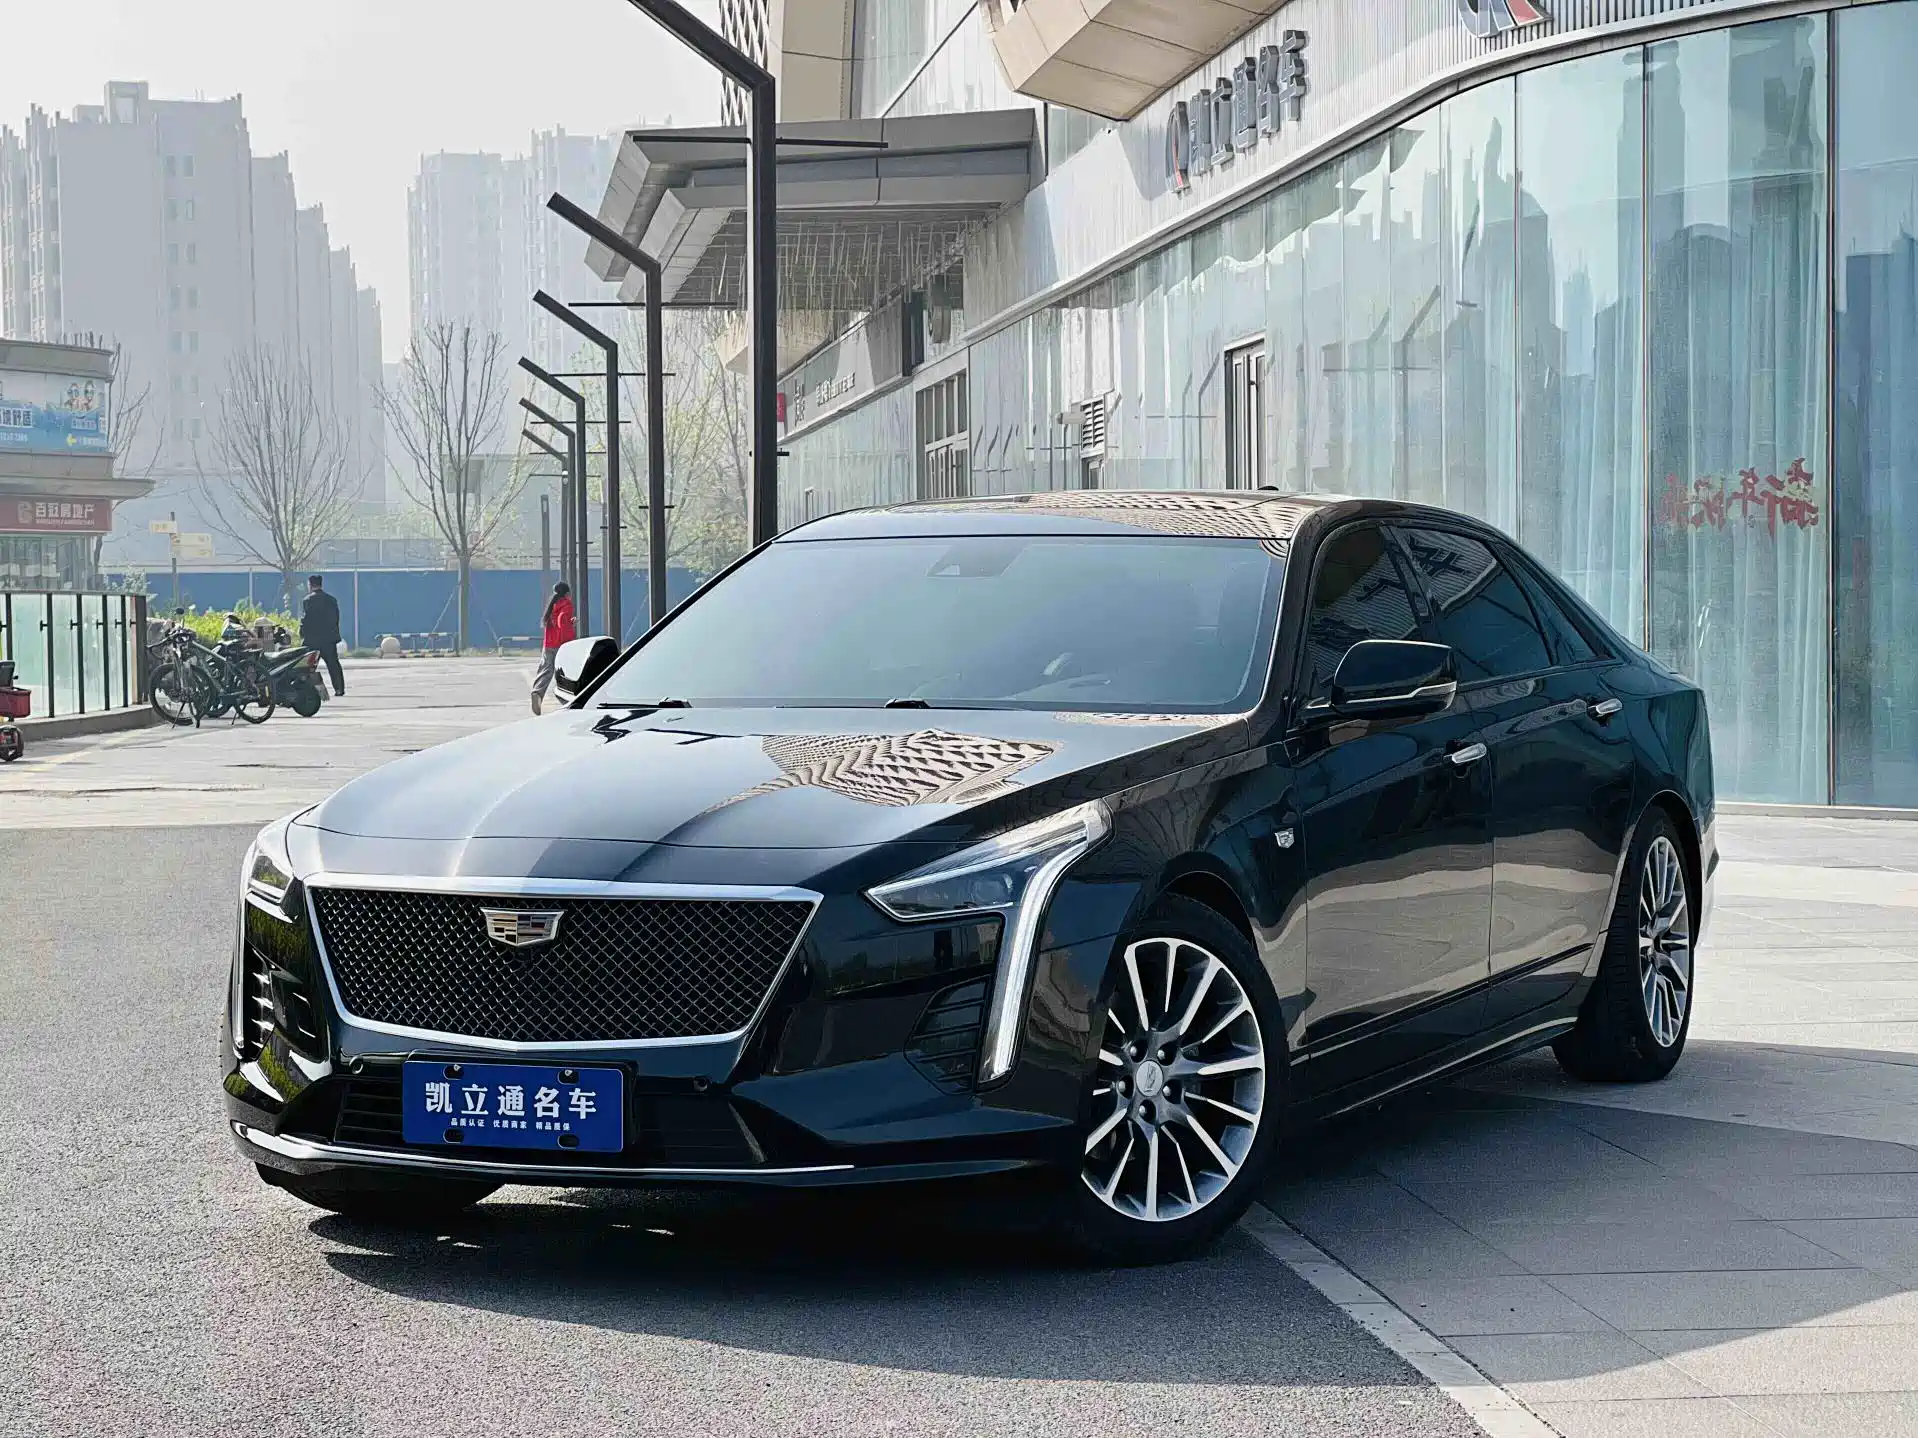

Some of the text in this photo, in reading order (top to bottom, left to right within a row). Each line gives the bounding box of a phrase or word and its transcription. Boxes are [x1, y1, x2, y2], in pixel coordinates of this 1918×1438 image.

[425, 1082, 597, 1120] 凯立通名车
